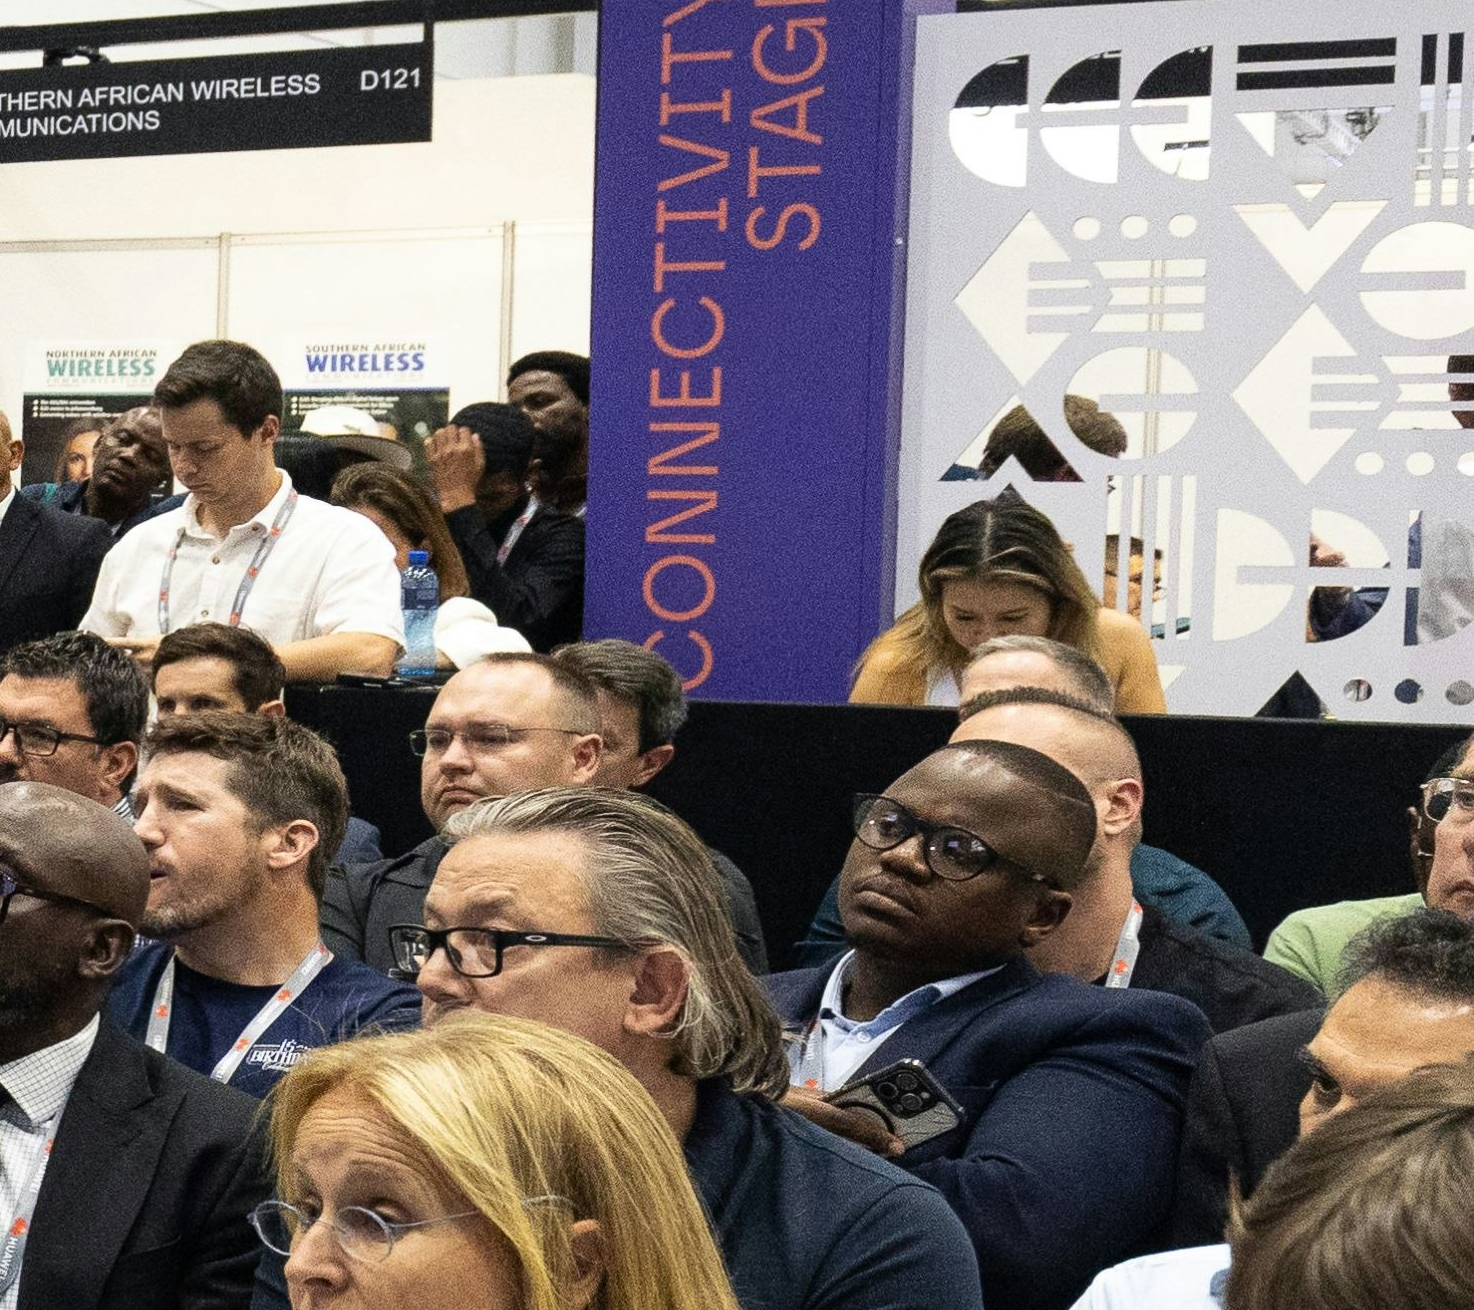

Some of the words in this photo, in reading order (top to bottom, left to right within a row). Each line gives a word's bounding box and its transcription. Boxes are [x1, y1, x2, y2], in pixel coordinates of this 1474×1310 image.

[361, 68, 421, 91] D121
[78, 82, 183, 108] AFRICAN
[190, 74, 321, 101] WIRELESS
[46, 350, 105, 358] NORTHERN
[109, 349, 157, 357] AFRICAN
[305, 344, 369, 353] SOUTHERN
[374, 343, 426, 351] AFRICAN
[47, 359, 156, 377] WIRELESS
[306, 352, 424, 372] WIRELESS
[250, 1050, 302, 1065] BIRTHD
